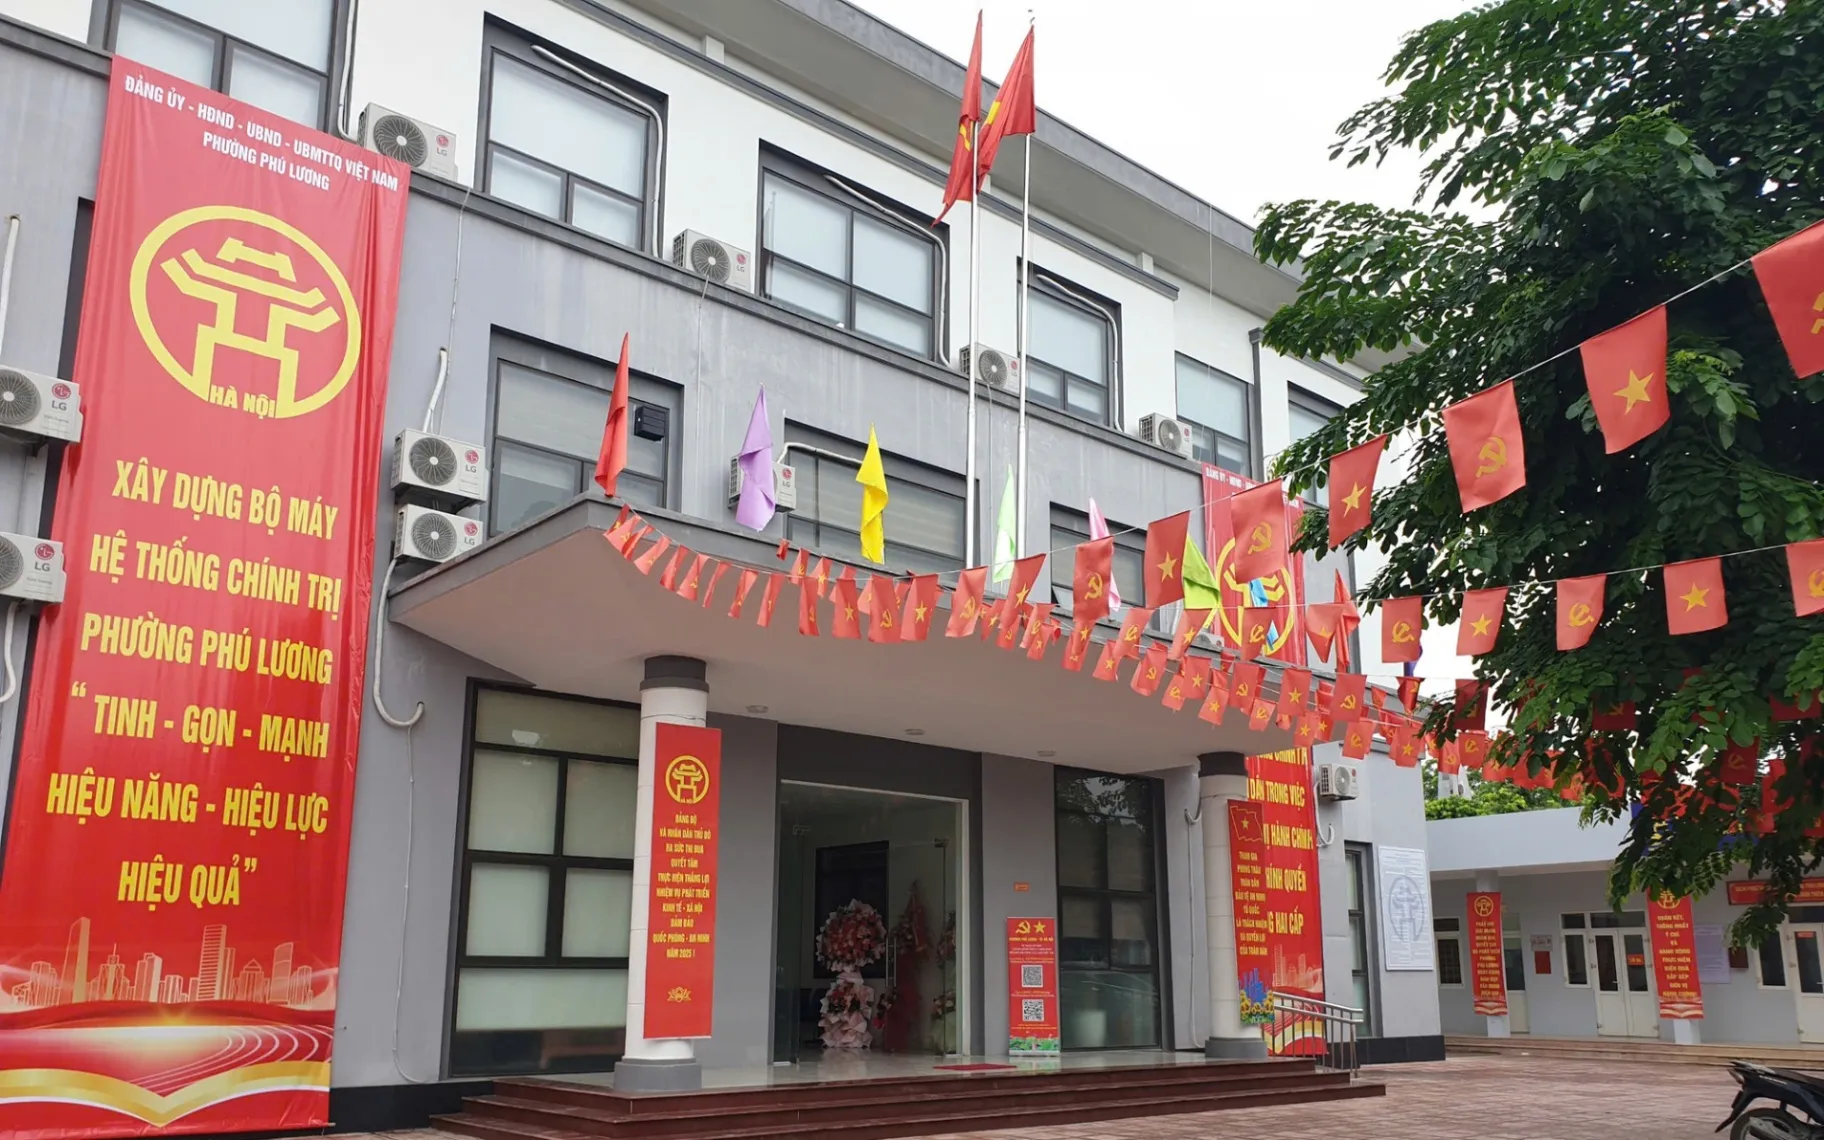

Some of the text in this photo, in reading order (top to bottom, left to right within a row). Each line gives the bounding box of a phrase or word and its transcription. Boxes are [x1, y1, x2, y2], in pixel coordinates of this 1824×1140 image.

[124, 74, 163, 103] ĐẢNG
[167, 87, 186, 111] ỦY
[198, 103, 234, 130] HĐND
[247, 121, 282, 148] UBND
[294, 140, 343, 172] UBMTTQ
[345, 159, 370, 181] VIỆT
[371, 169, 398, 192] NAM
[203, 132, 330, 190] PHƯỜNG PHÚ LƯƠNG
[437, 147, 448, 157] LG
[51, 401, 67, 411] LG
[210, 384, 276, 419] HÀ NỘI
[465, 465, 477, 473] LG
[782, 480, 791, 488] LG
[112, 456, 338, 540] XÂY DỰNG BỘ MÁY
[464, 537, 475, 546] LG
[34, 562, 50, 572] LG
[89, 529, 343, 621] HỆ THỐNG CHÍNH TRỊ
[80, 612, 333, 684] PHƯỜNG PHÚ LƯƠNG
[94, 695, 157, 738] TINH
[164, 720, 174, 729] -
[182, 705, 237, 753] GỌN
[259, 714, 330, 762] MẠNH
[46, 767, 329, 840] HIỆU NĂNG - HIỆU LỰC
[1265, 780, 1289, 805] TRONG
[1289, 781, 1305, 811] VIỆC
[1271, 820, 1290, 848] HÀNH
[1291, 824, 1314, 850] CHÍNH
[118, 854, 183, 911] HIỆU
[1265, 863, 1283, 890] HÍNH
[1275, 912, 1288, 934] HAI
[1289, 905, 1304, 935] CẤP
